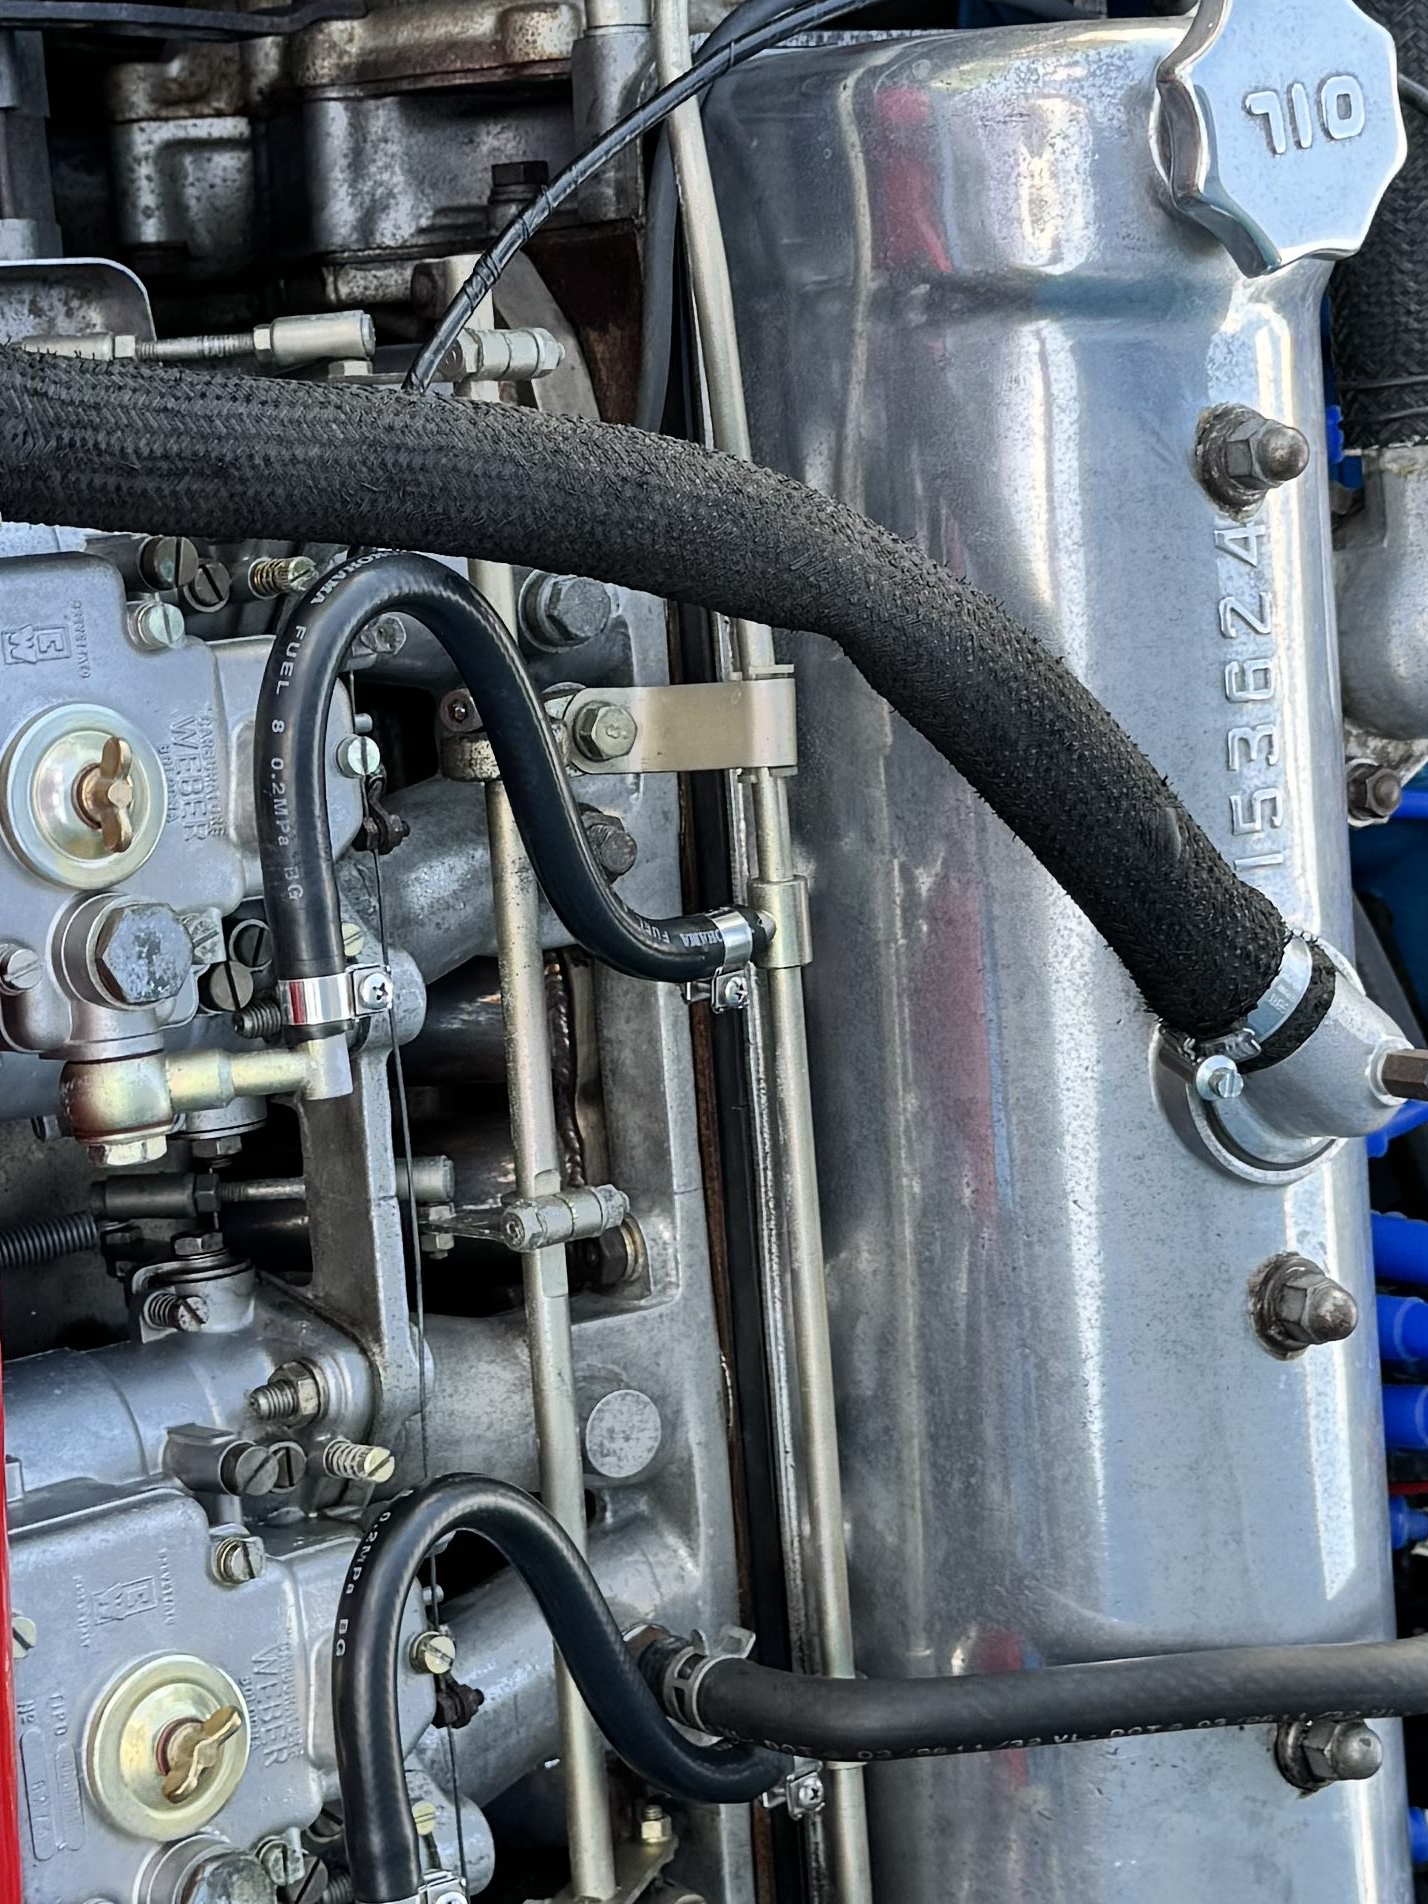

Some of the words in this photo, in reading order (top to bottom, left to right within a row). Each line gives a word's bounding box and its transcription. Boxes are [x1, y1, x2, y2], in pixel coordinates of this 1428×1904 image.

[1245, 74, 1367, 156] OIL
[276, 625, 307, 696] FUEL
[1212, 520, 1285, 873] 153624
[271, 719, 285, 734] 8
[168, 715, 209, 842] WEBER
[270, 757, 293, 847] 0.2MPa
[284, 865, 304, 901] BG
[635, 916, 670, 944] FUEL
[344, 1510, 393, 1597] 0.2MPa
[334, 1618, 349, 1658] BG
[252, 1642, 290, 1768] WEBER
